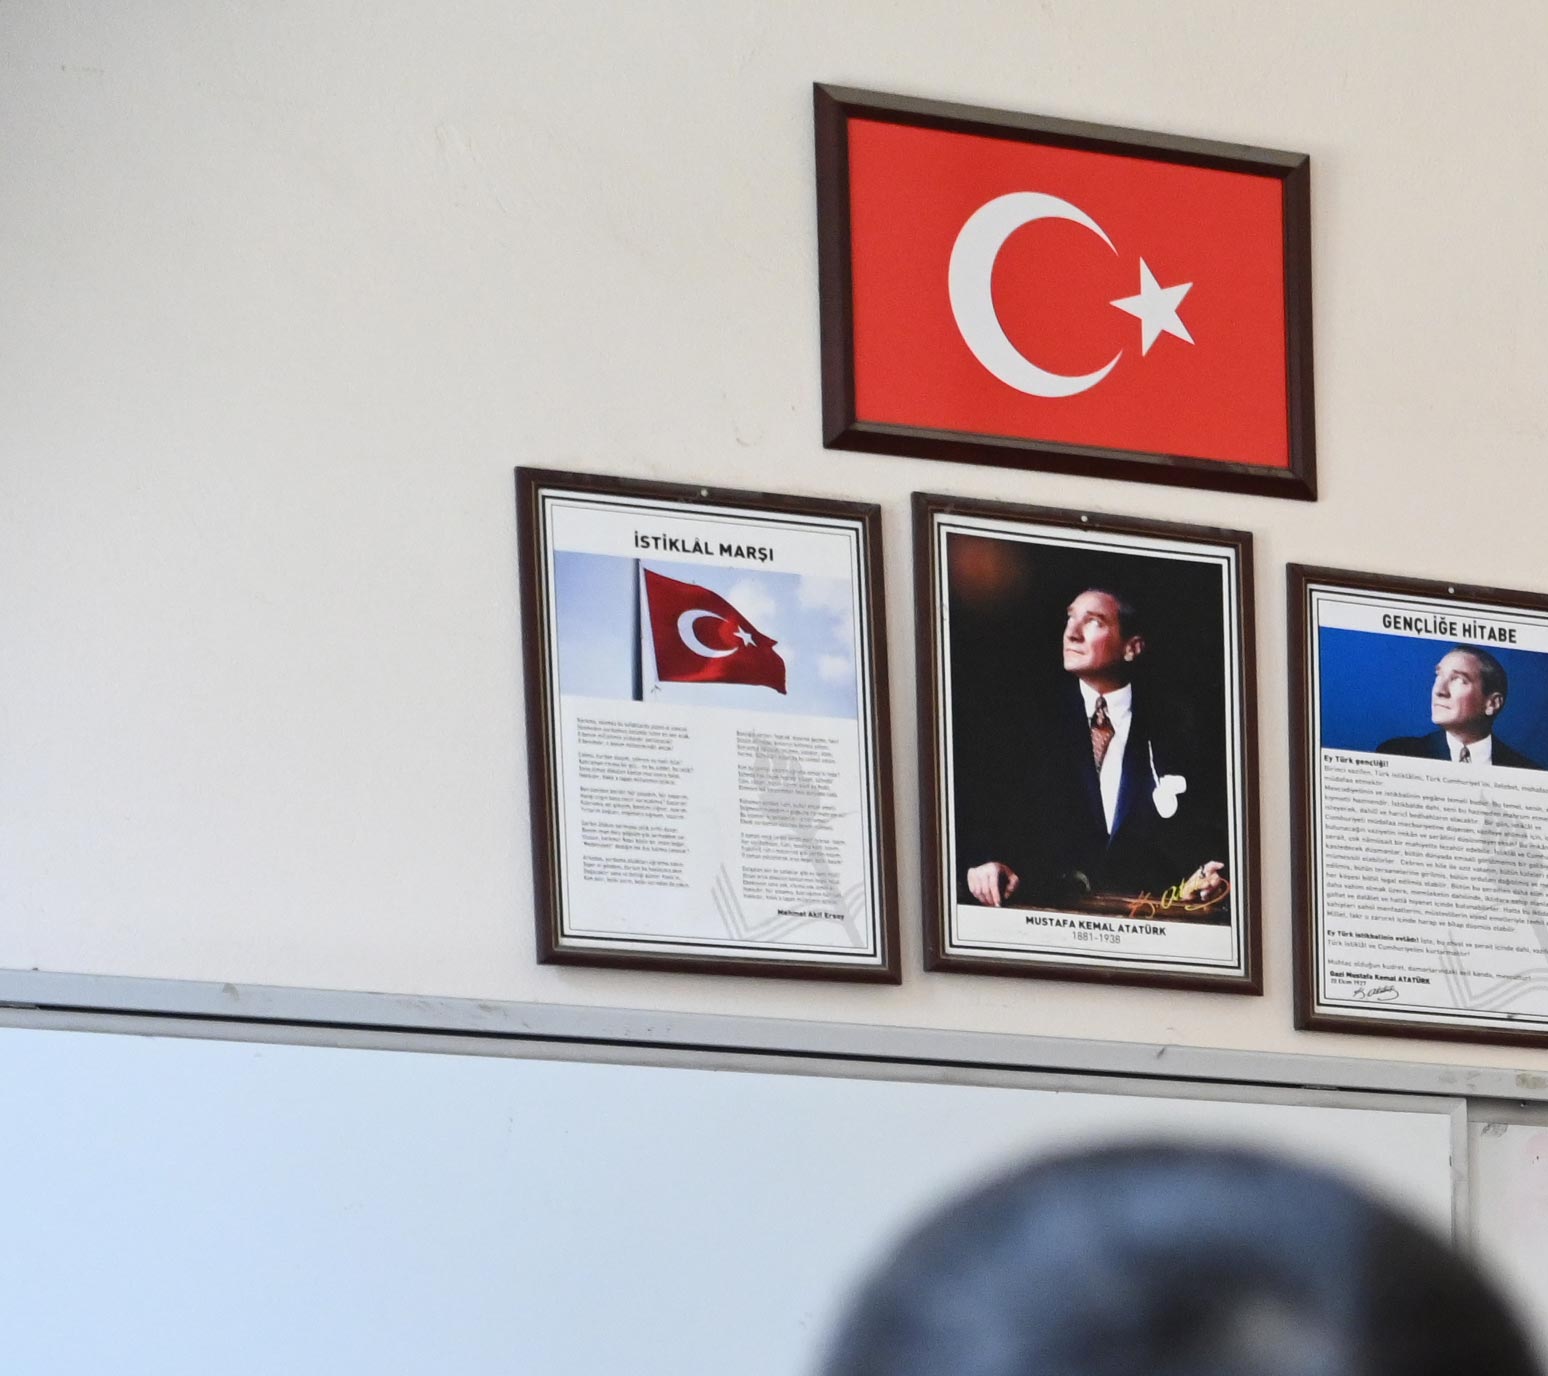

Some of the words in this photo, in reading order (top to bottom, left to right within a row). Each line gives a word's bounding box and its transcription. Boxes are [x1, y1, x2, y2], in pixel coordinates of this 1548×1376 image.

[634, 531, 714, 555] İSTİKLÂL
[720, 543, 774, 562] MARŞI
[1383, 614, 1458, 636] GENÇLİĞE
[1462, 620, 1517, 643] HİTABE
[1323, 754, 1332, 762] Ey
[1335, 755, 1352, 764] Türk
[1025, 916, 1076, 928] MUSTAFA
[1078, 920, 1115, 932] KEMAL
[1118, 924, 1166, 936] ATATÜRK
[1072, 931, 1121, 944] 1881-1938
[1329, 970, 1344, 978] Gazi
[1346, 972, 1373, 981] Mustafa
[1374, 974, 1397, 982] Kemal
[1398, 976, 1430, 985] ATATÜRK
